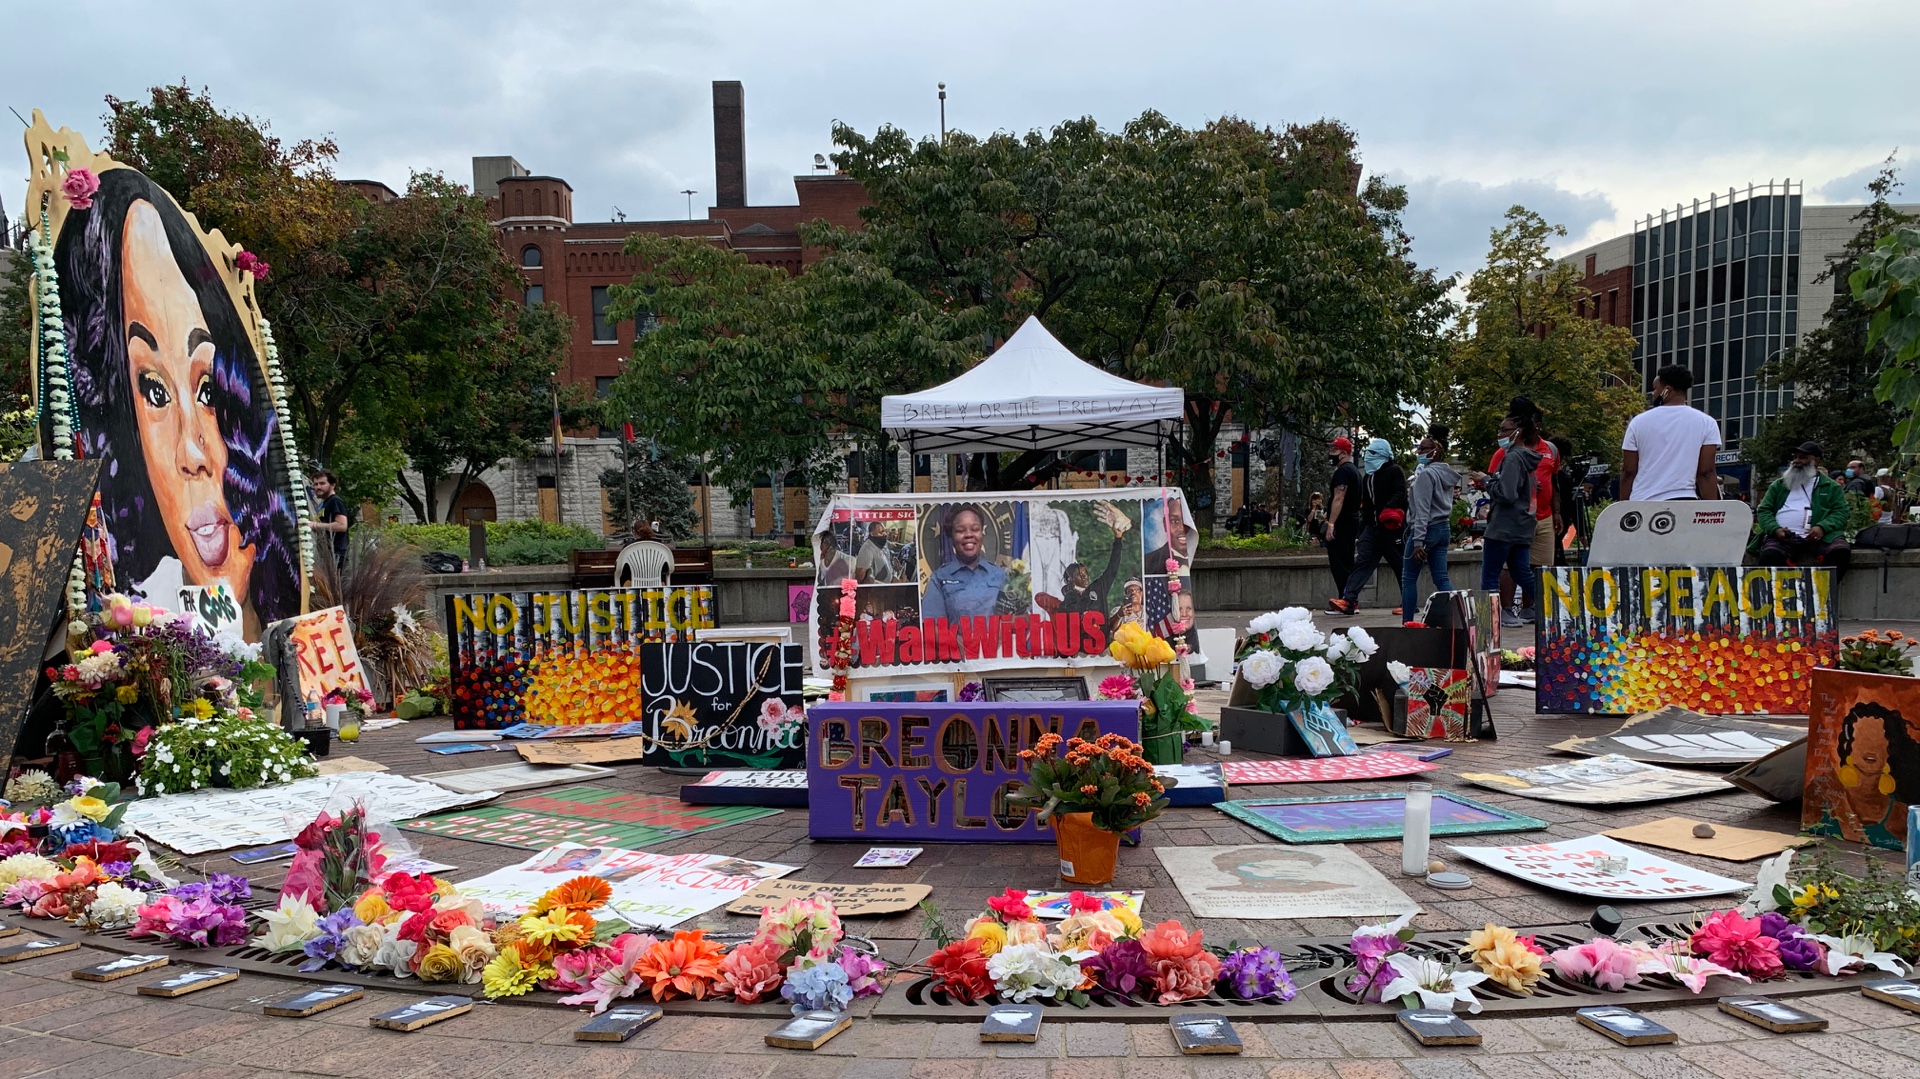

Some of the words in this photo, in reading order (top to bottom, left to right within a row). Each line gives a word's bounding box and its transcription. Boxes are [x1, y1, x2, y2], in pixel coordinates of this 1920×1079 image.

[979, 402, 1005, 420] OR
[1009, 400, 1040, 418] THE
[1590, 465, 1607, 474] LOUIS
[854, 511, 893, 519] LITTLE
[1542, 569, 1619, 619] NO
[1642, 569, 1831, 620] PEACE!
[199, 587, 237, 629] COPS
[453, 593, 519, 635] NO
[532, 588, 715, 635] JUSTICE
[824, 610, 1106, 667] #WalkWithUS
[291, 627, 356, 682] REE
[642, 642, 804, 697] JUSTICE
[711, 696, 732, 712] for
[746, 771, 807, 779] FUC
[838, 774, 1049, 833] TAYLO
[1263, 805, 1405, 825] BREE
[406, 820, 556, 847] slaver
[1499, 843, 1558, 855] THE
[1504, 849, 1610, 862] COLOR
[1515, 862, 1552, 870] OF
[1531, 869, 1615, 880] SKIN
[1569, 880, 1639, 888] NOT
[1661, 876, 1688, 885] A
[816, 885, 845, 893] ON
[855, 886, 905, 894] YOUR
[1602, 884, 1714, 896] CRIME
